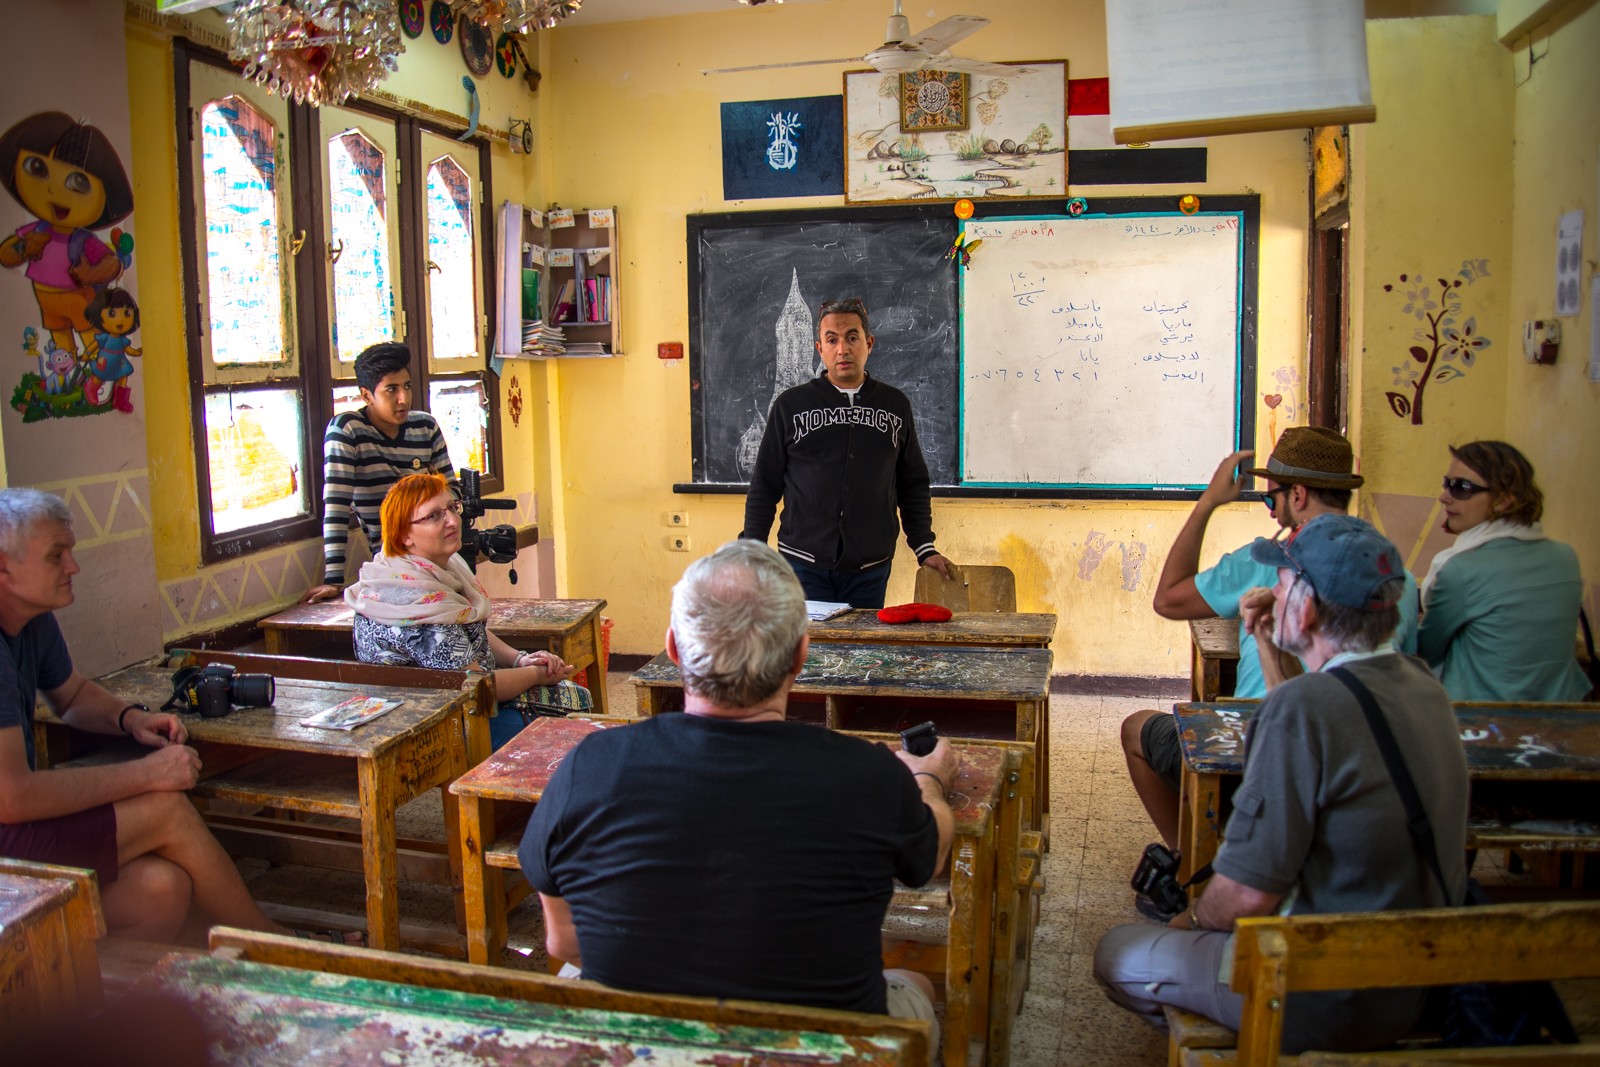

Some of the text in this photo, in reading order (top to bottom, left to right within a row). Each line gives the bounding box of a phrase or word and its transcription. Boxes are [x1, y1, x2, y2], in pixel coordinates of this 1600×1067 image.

[1161, 318, 1192, 332] ماريا
[1016, 370, 1024, 379] ٥
[1034, 368, 1041, 383] ٤
[1054, 368, 1065, 382] ٣
[1071, 371, 1081, 381] ٢
